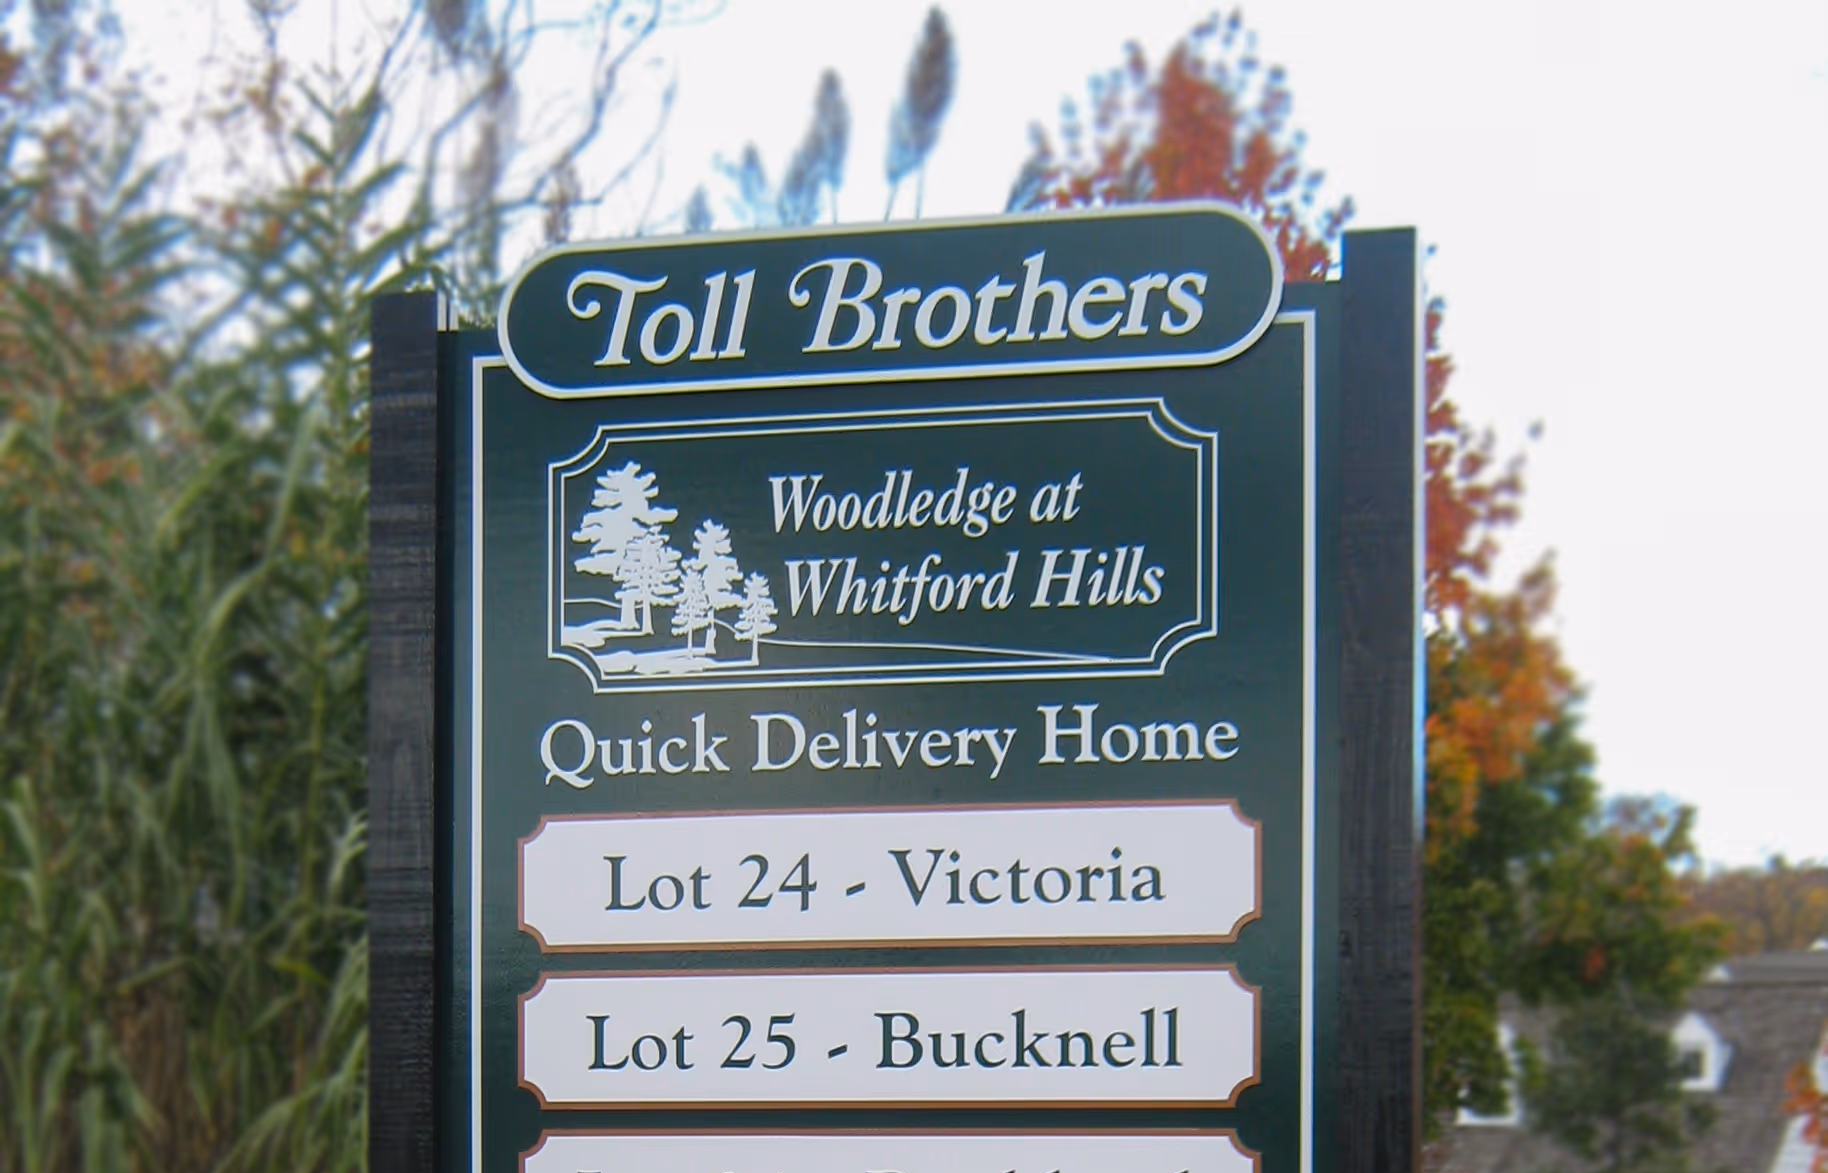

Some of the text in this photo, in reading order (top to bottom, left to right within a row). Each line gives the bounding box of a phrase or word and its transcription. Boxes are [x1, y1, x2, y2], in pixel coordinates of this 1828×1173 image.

[567, 251, 1207, 365] Toll Brothers
[769, 468, 1083, 537] Woodledge at
[785, 546, 1164, 624] Whitford Hills
[541, 704, 1238, 788] Quick Delivery Home
[604, 847, 1164, 911] Lot 24 - Victoria
[586, 1008, 1182, 1070] Lot 25 - Bucknell
